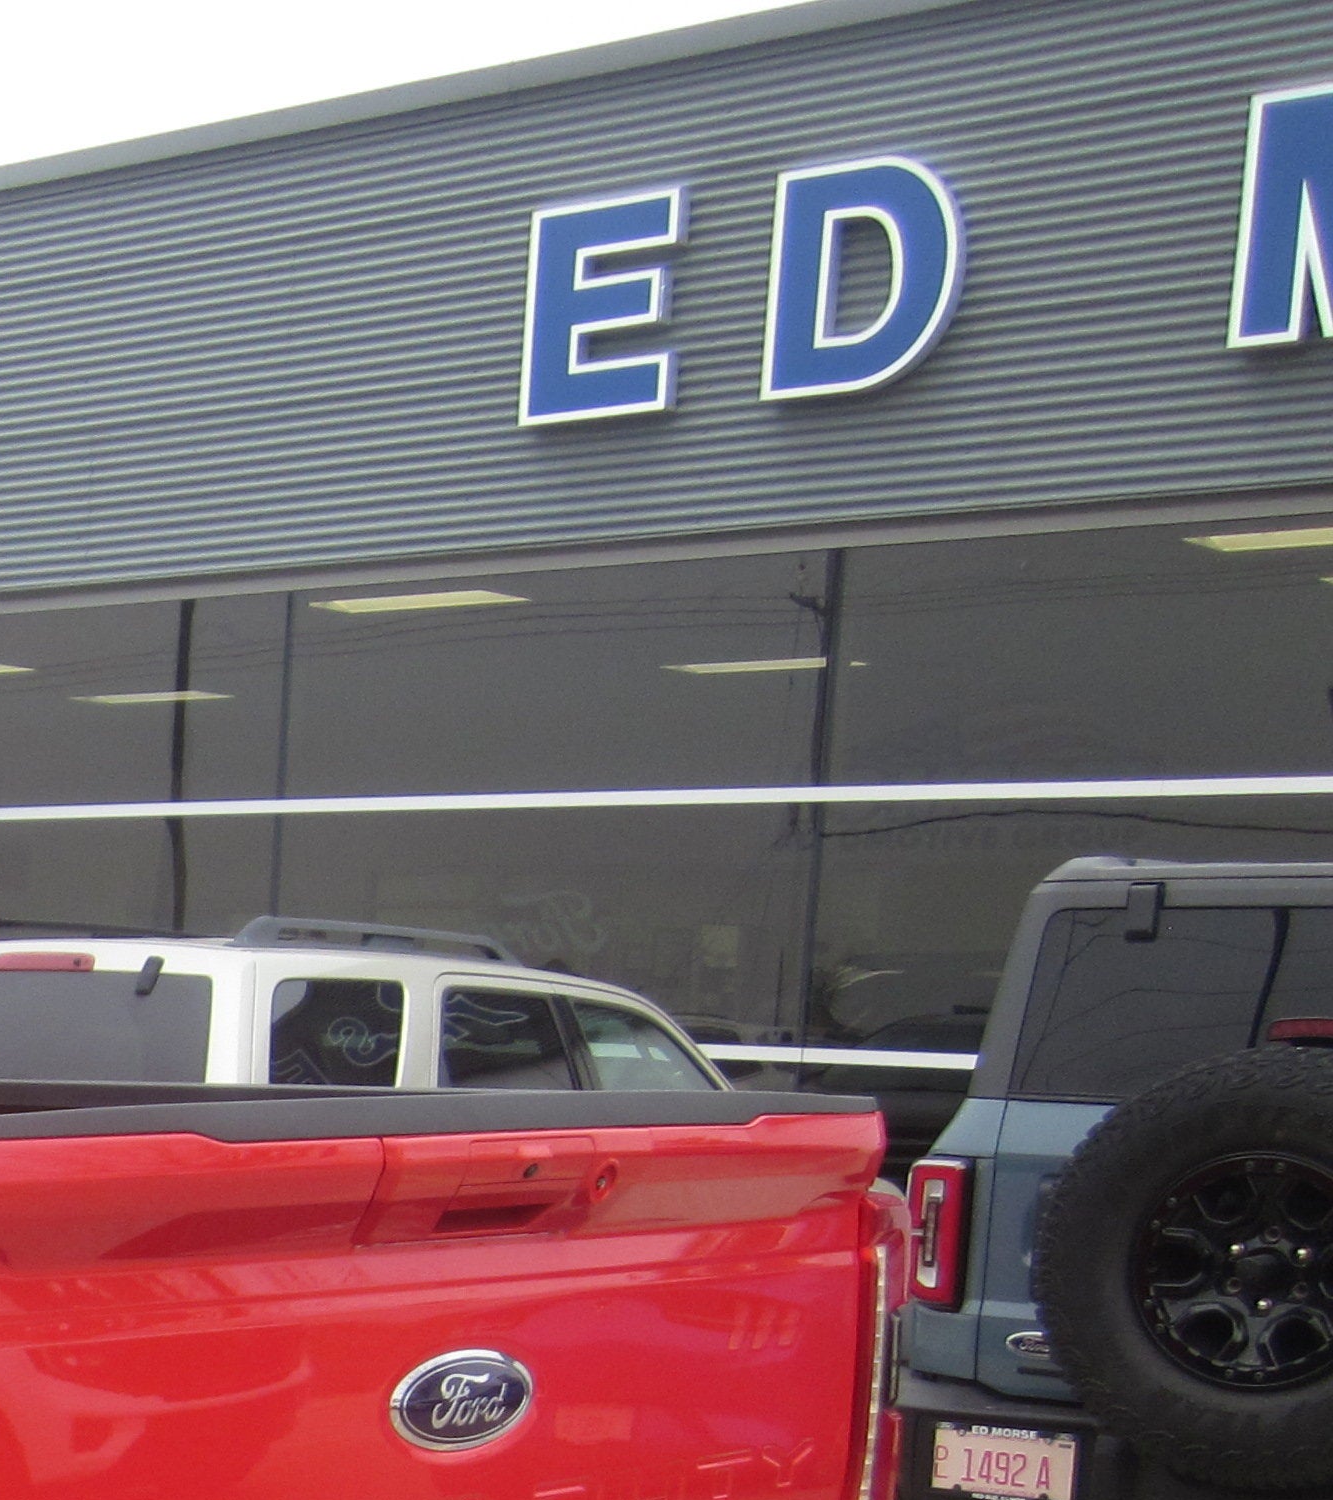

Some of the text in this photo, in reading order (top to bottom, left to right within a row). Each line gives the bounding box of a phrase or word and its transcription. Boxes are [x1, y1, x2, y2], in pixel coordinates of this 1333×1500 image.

[518, 155, 966, 427] ED
[431, 1372, 509, 1429] Ford
[971, 1425, 1038, 1440] ED MORSE
[961, 1449, 1027, 1488] 1492
[1036, 1456, 1050, 1490] A
